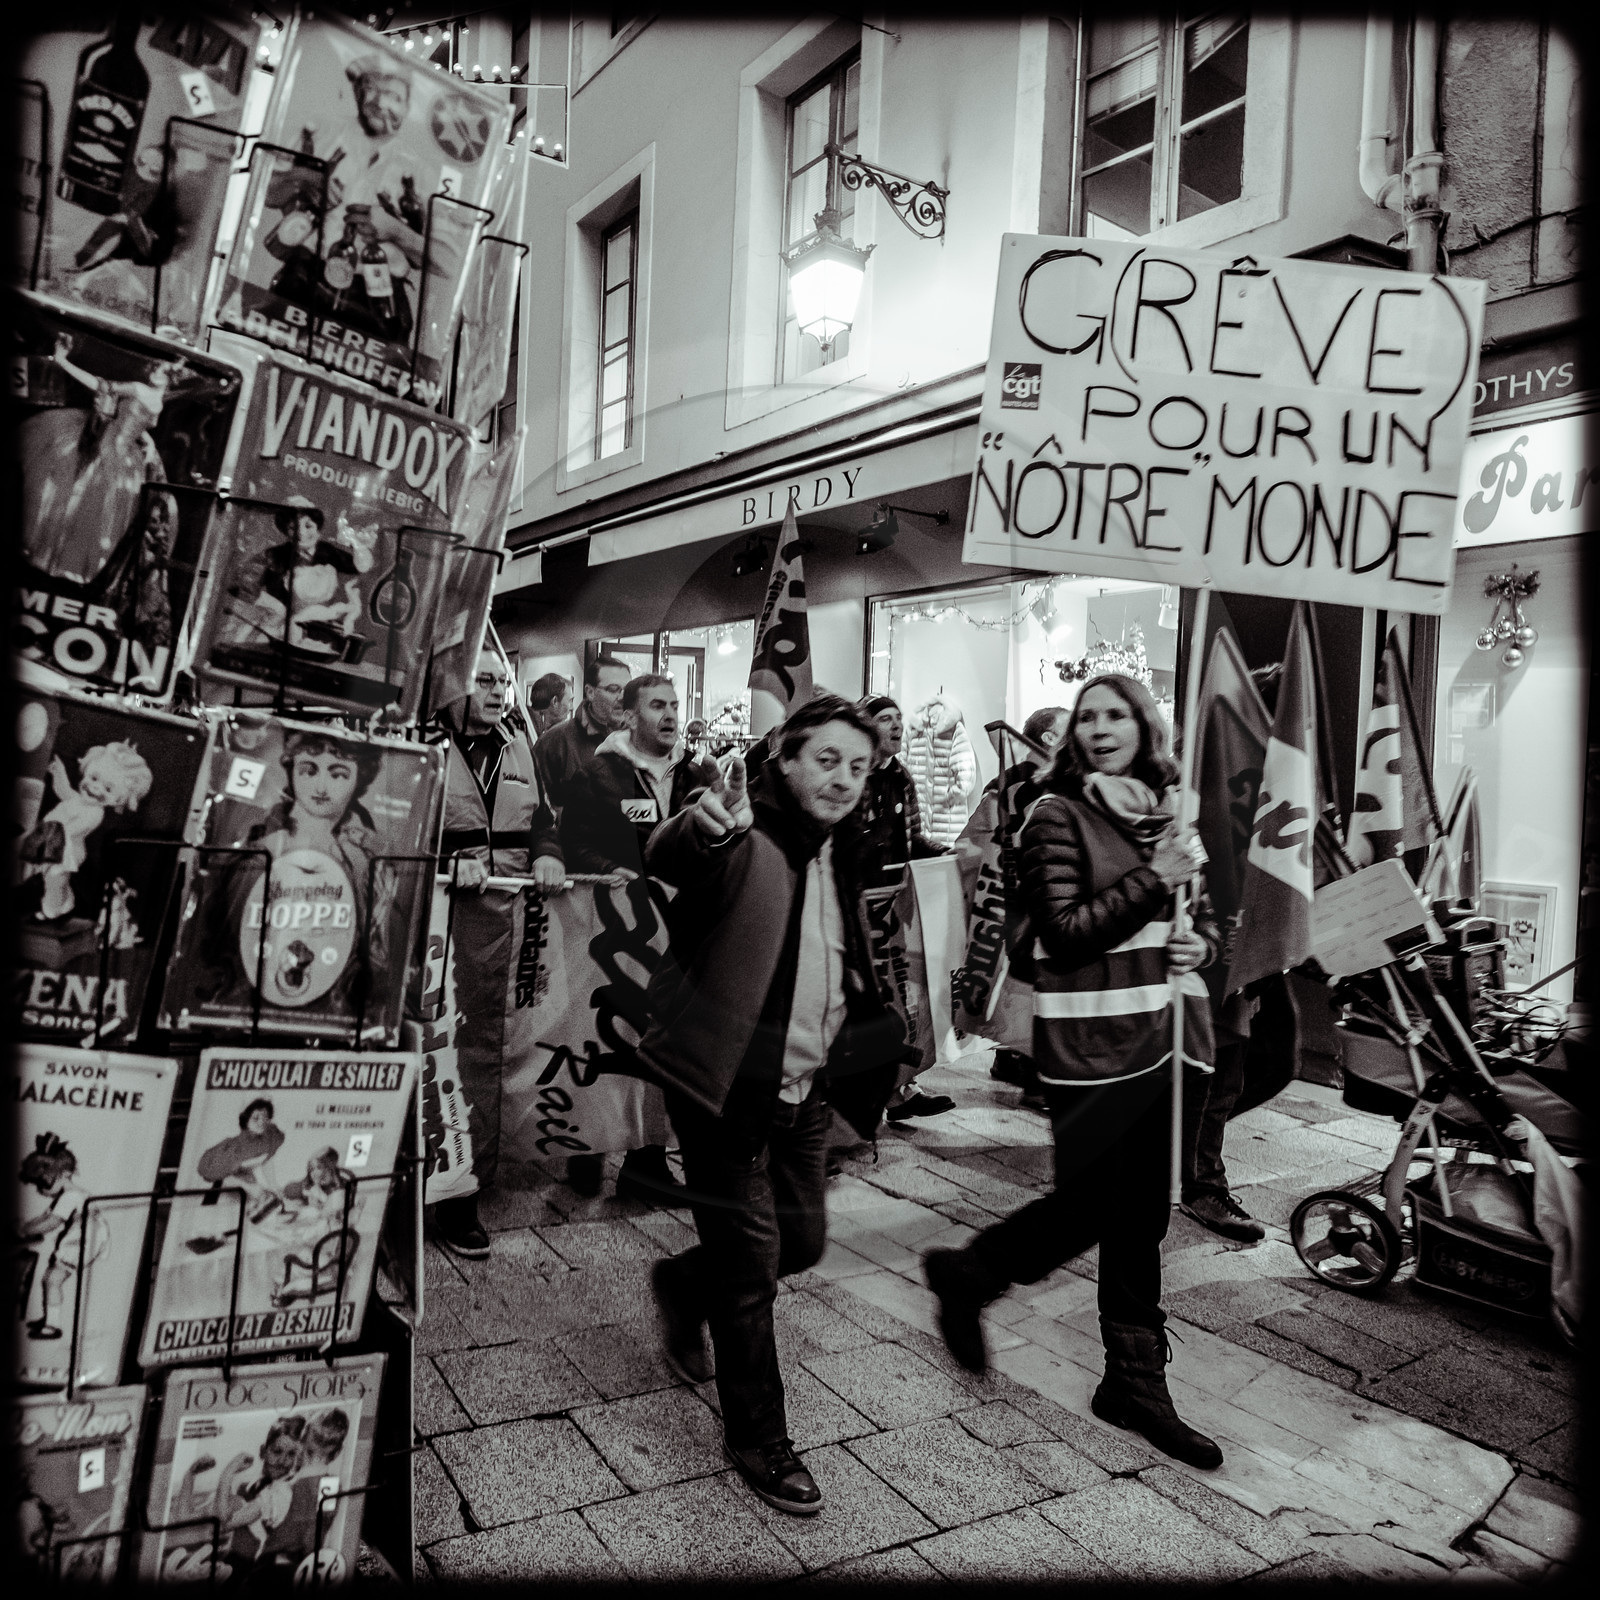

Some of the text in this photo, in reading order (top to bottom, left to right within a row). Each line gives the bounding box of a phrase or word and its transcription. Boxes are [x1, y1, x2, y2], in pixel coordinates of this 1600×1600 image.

[1002, 375, 1041, 399] cgt
[261, 367, 461, 515] VIANDOX
[1080, 385, 1435, 473] POUR UN
[283, 453, 366, 492] PRODUI
[742, 466, 863, 526] BIRDY
[1203, 475, 1459, 588] MONDE
[45, 1062, 108, 1080] SAVON
[211, 1060, 400, 1091] CHOCOLAT BESNIER
[534, 1040, 601, 1156] Rail
[452, 1131, 465, 1168] NATIONAL
[159, 1313, 268, 1350] CHOCOLAT
